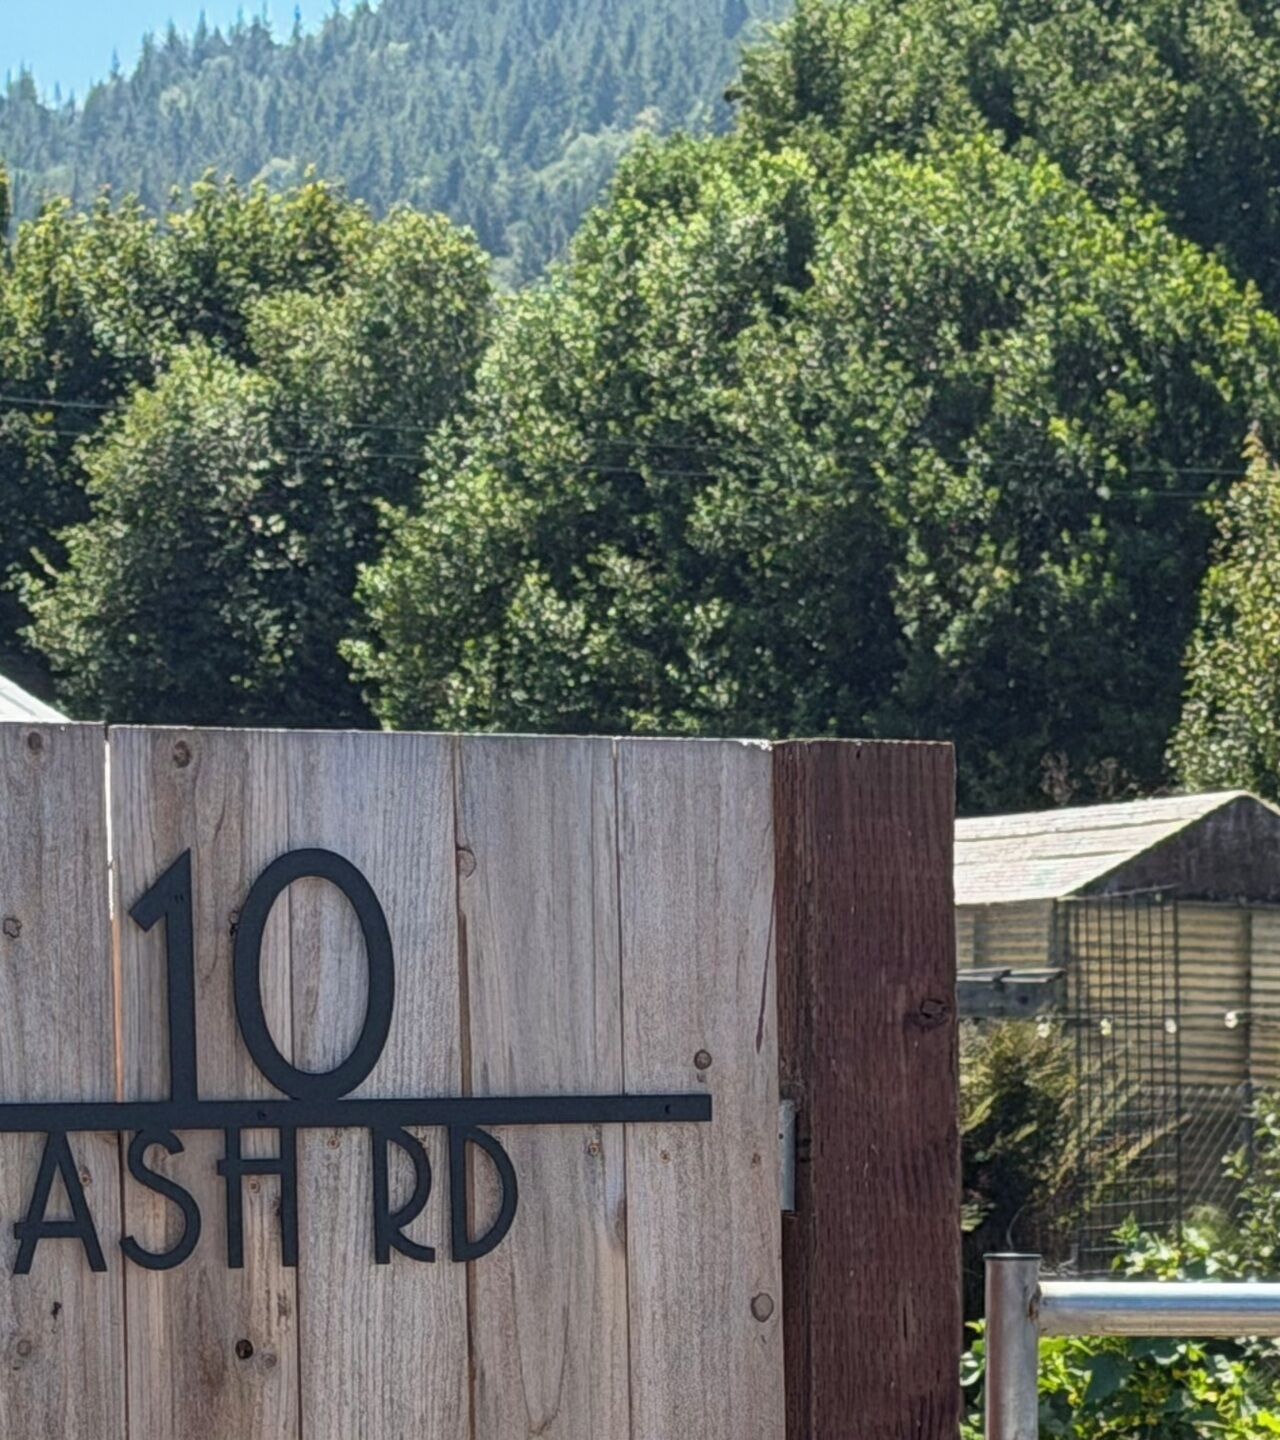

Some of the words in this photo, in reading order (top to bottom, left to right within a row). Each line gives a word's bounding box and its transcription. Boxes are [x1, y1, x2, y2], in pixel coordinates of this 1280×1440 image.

[128, 847, 395, 1102] 10
[13, 1126, 298, 1275] ASH
[372, 1124, 519, 1265] RD
